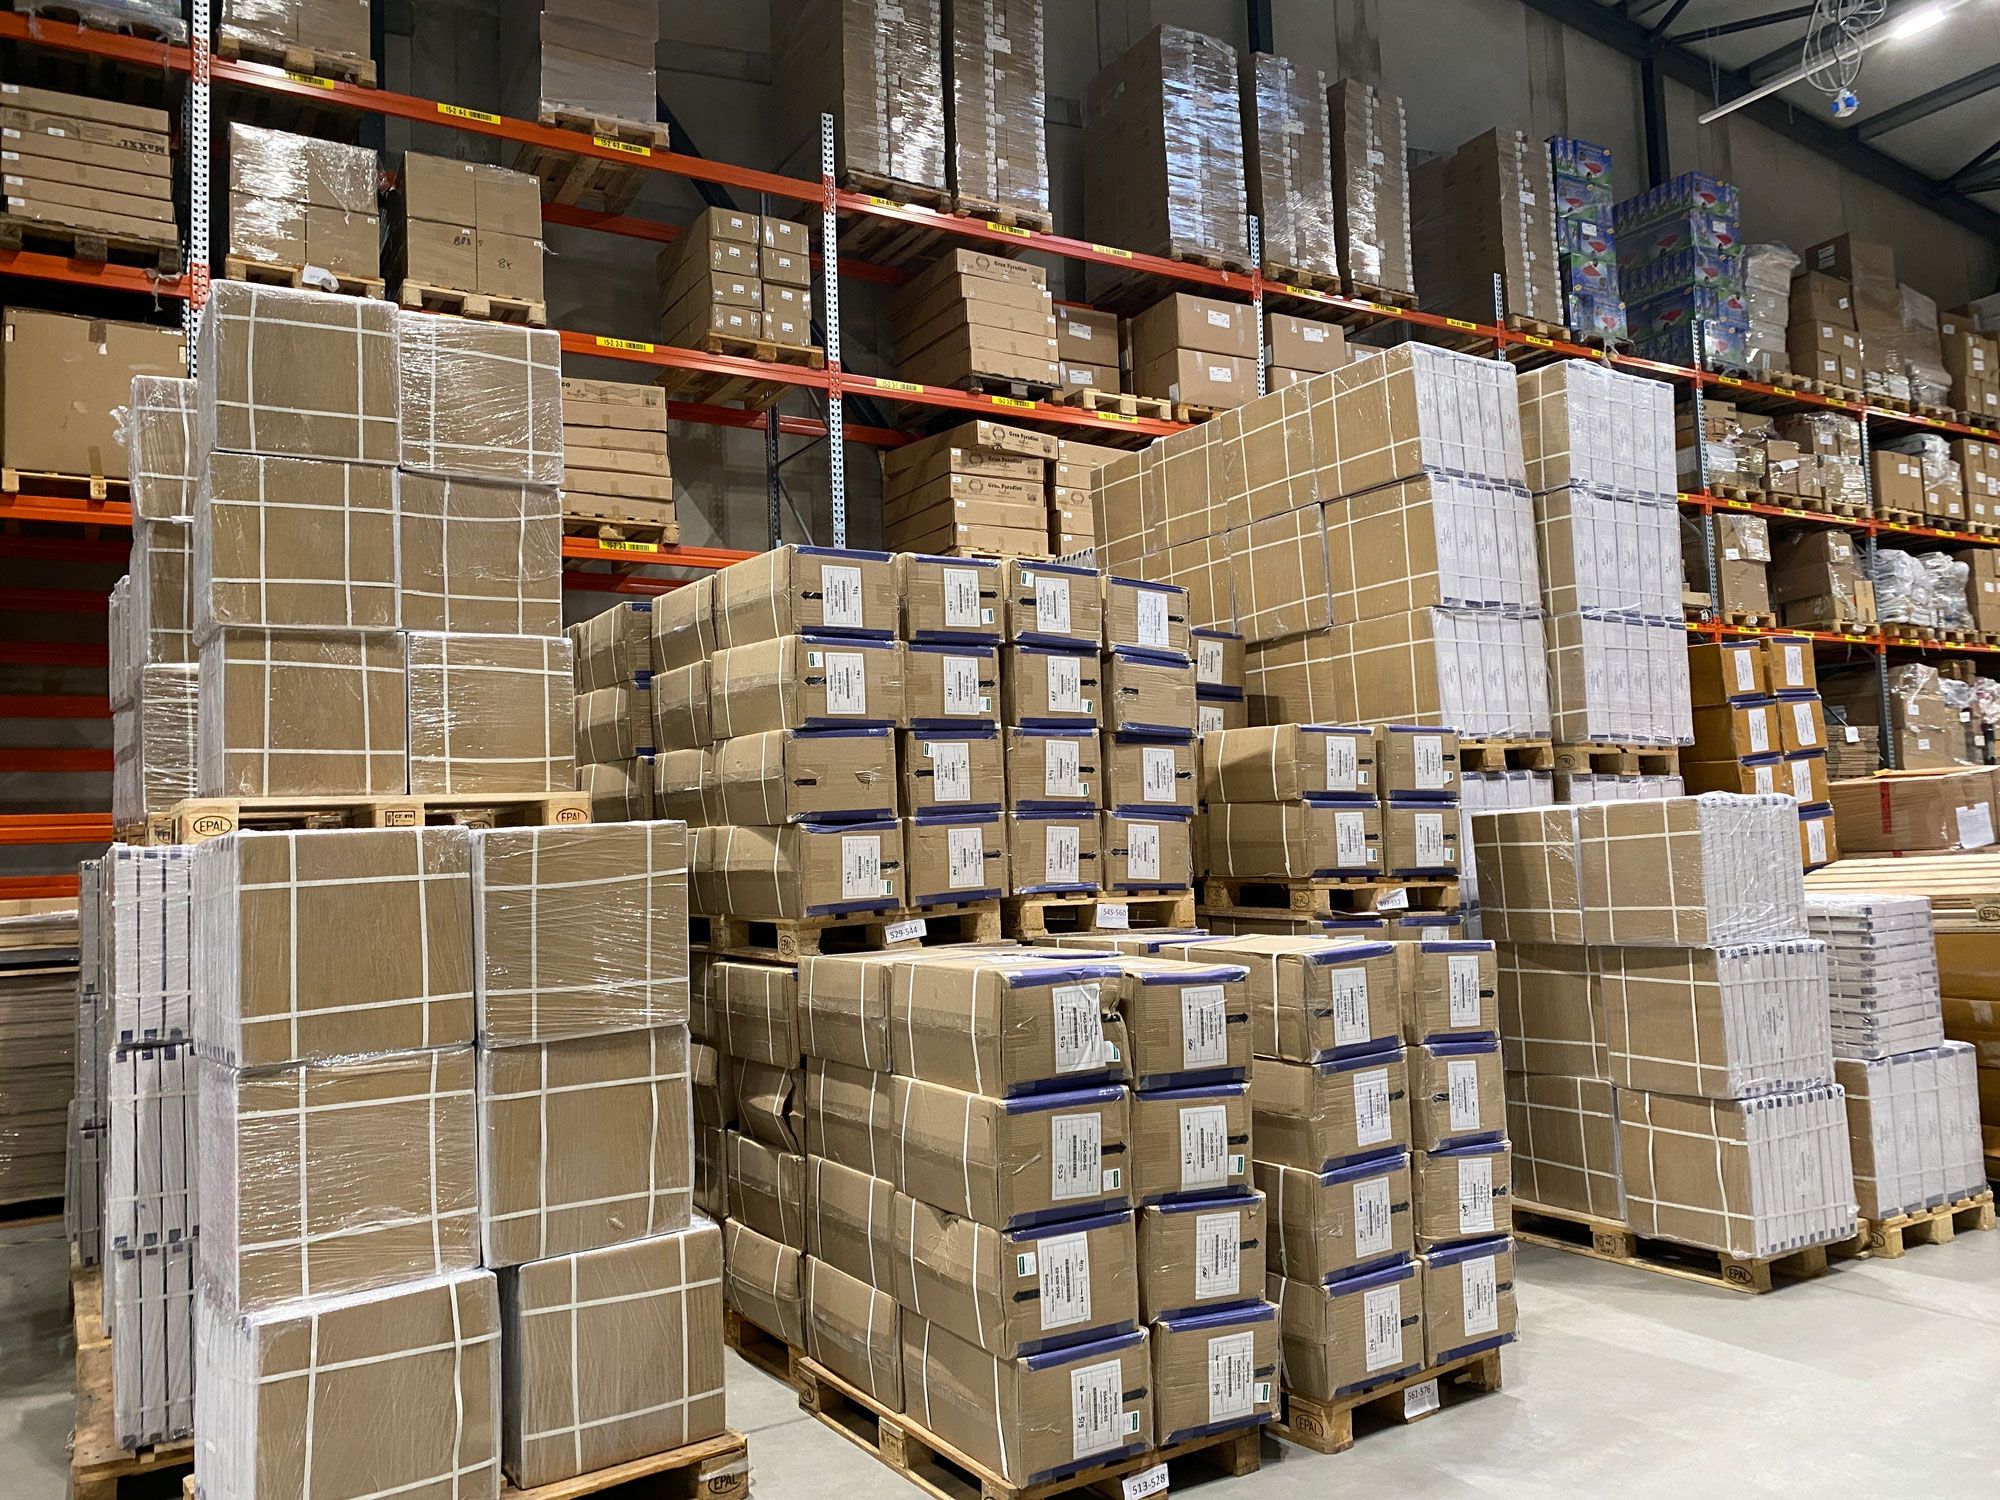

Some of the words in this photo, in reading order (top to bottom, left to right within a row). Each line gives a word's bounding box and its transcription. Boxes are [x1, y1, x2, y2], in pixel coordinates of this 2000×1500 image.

[200, 820, 226, 832] EPAL
[1103, 907, 1126, 917] 545-560
[890, 925, 918, 940] 529-544
[1729, 1268, 1748, 1281] EPAL
[1407, 1384, 1431, 1402] 561-576
[1299, 1417, 1319, 1436] EPAL
[714, 1473, 737, 1490] EPAL
[1132, 1472, 1166, 1496] 513-528
